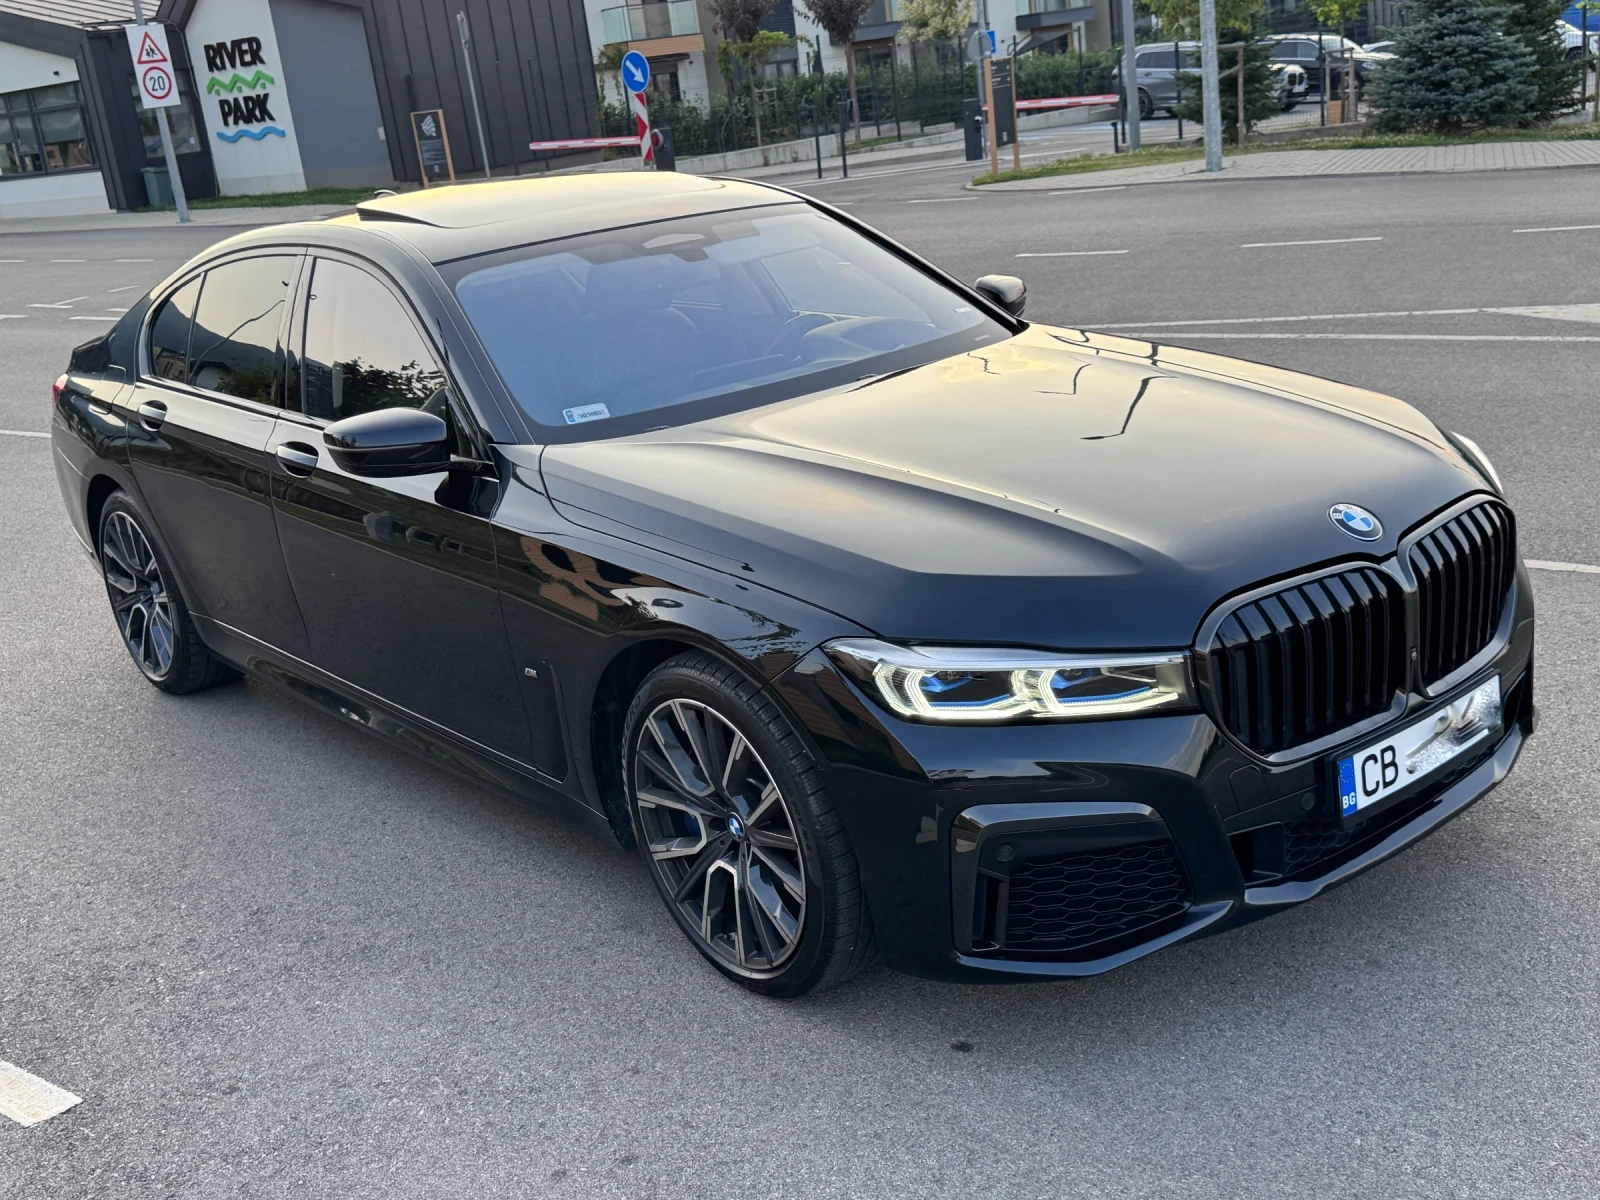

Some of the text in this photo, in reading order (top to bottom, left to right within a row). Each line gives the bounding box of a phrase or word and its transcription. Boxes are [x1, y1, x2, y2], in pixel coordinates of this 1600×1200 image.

[203, 36, 266, 72] RIVER
[149, 76, 166, 92] 20
[218, 93, 276, 127] PARK
[1361, 745, 1399, 797] CB
[1342, 792, 1356, 809] BG
